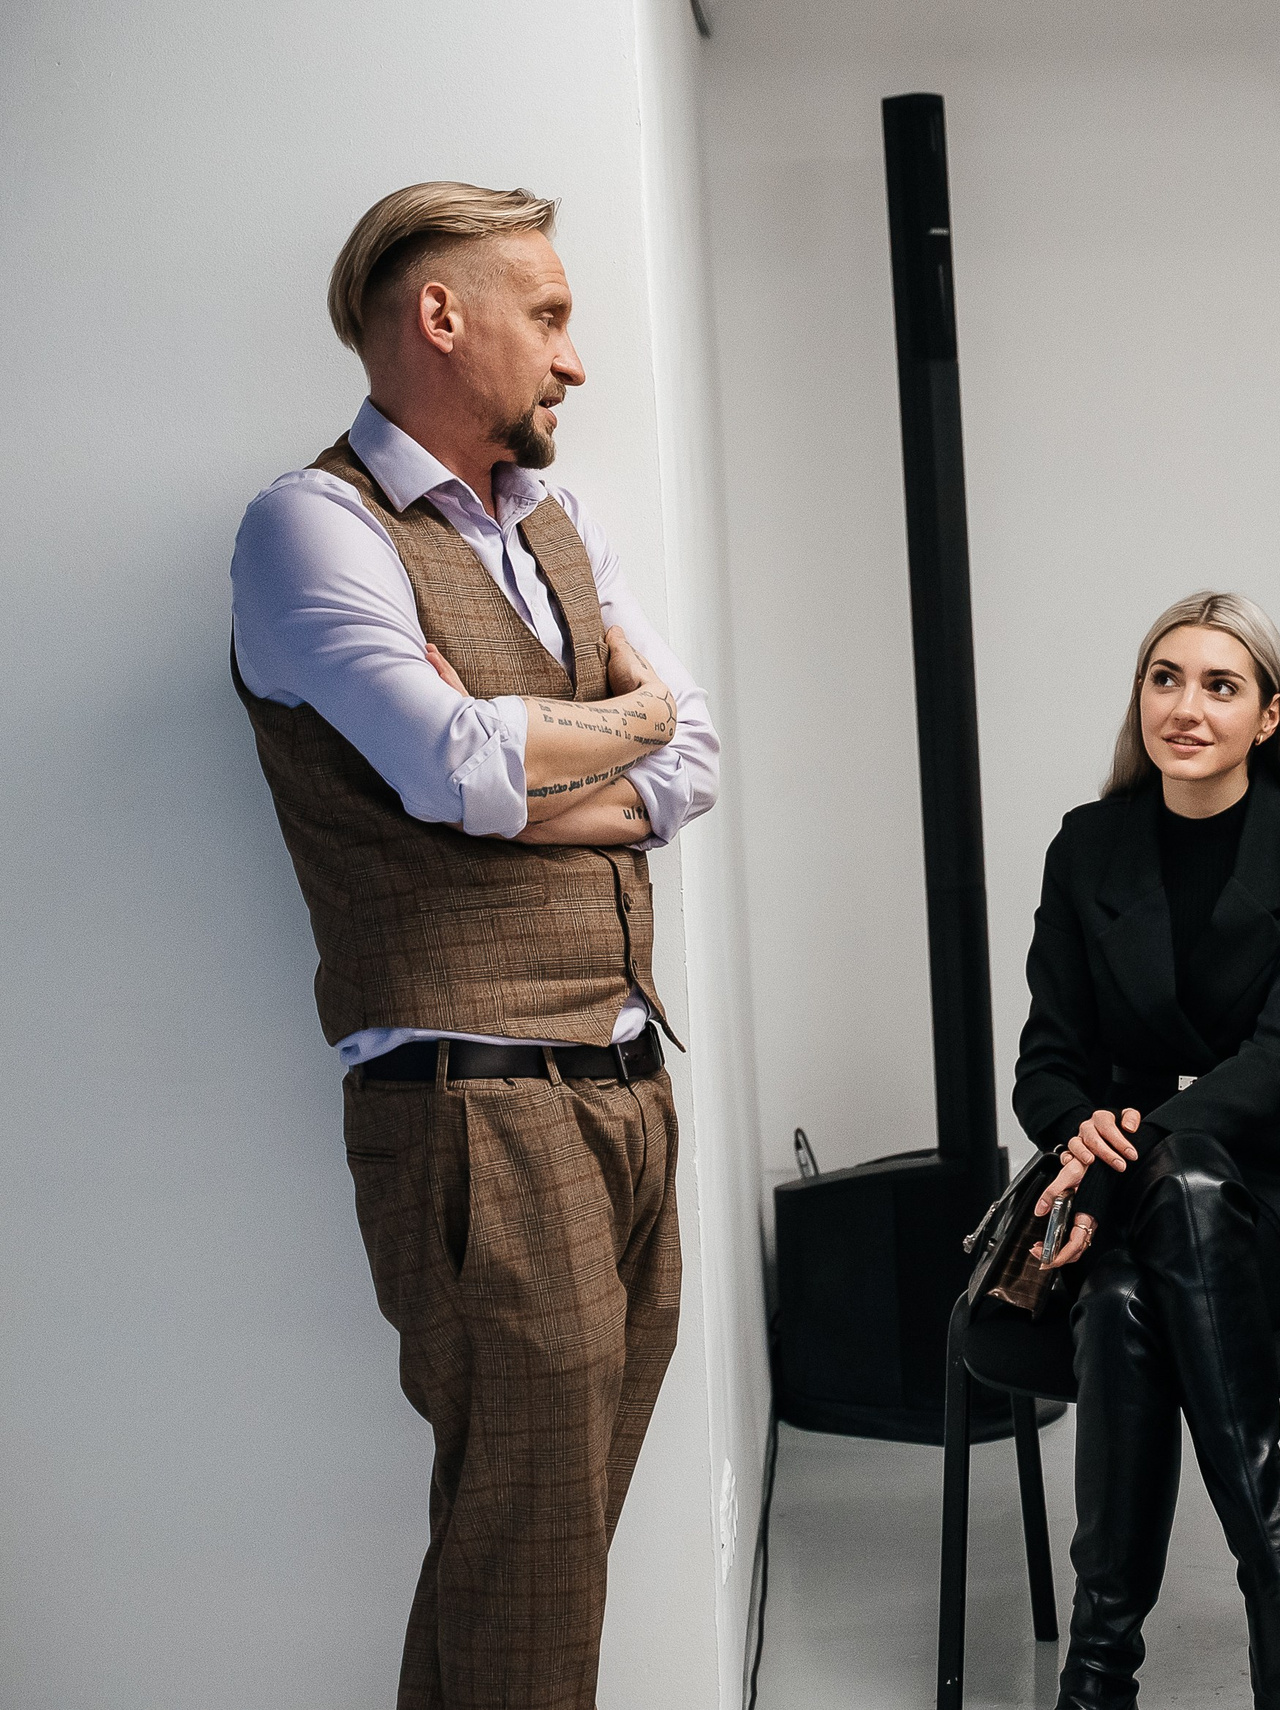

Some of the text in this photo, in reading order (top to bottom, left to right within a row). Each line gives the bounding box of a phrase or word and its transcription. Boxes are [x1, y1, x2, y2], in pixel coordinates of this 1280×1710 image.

[575, 719, 613, 735] divertido
[654, 722, 666, 732] HO
[568, 777, 584, 792] jest
[585, 771, 610, 785] dobrze
